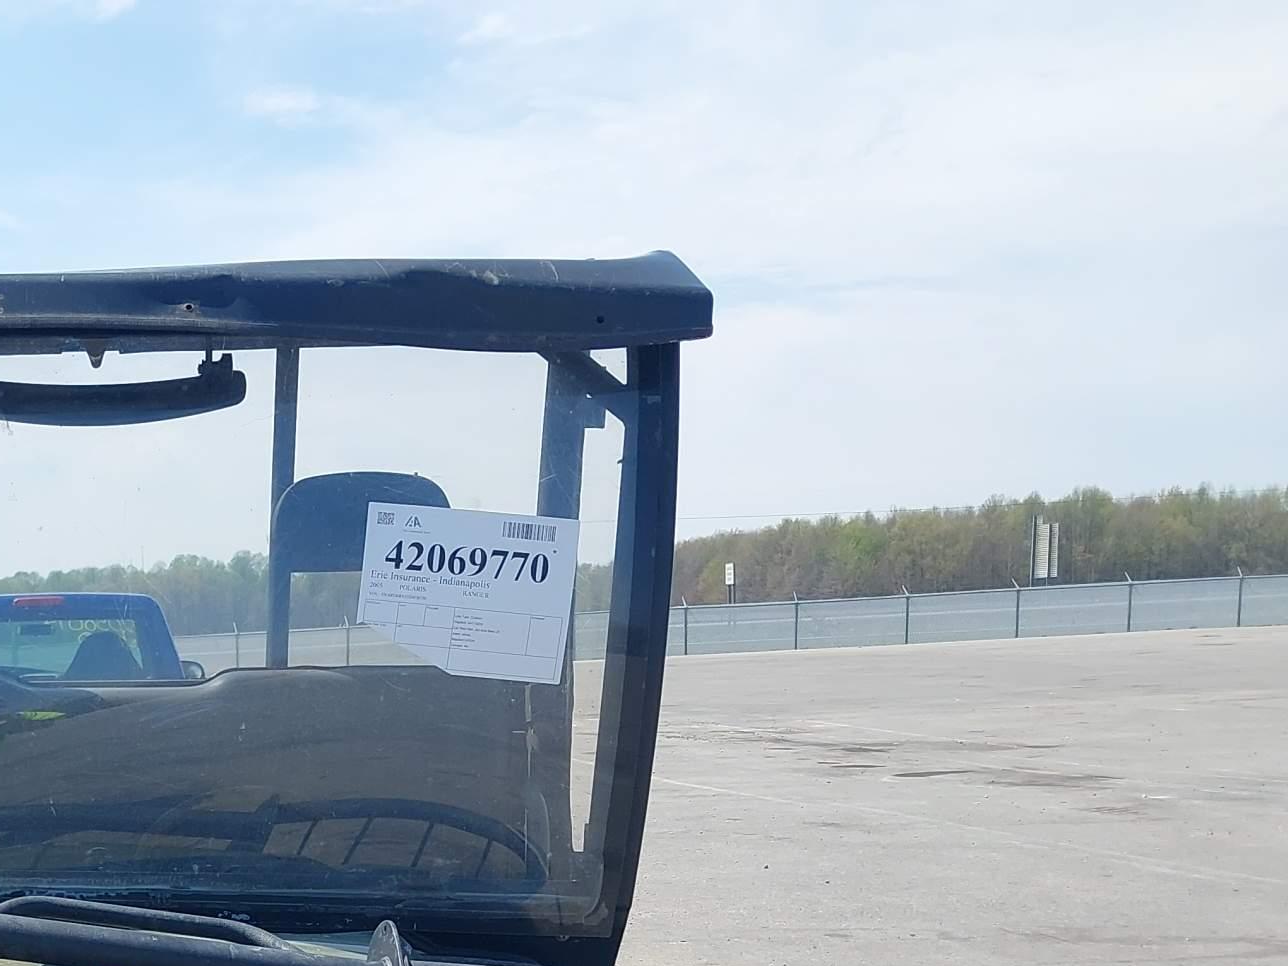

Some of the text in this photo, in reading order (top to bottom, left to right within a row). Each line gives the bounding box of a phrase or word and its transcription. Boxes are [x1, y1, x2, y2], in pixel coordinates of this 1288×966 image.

[385, 540, 549, 583] 42069770
[391, 571, 431, 583] Insurance
[439, 576, 490, 589] Indianapolis
[399, 584, 427, 593] POLARIS
[462, 590, 489, 599] RANGER
